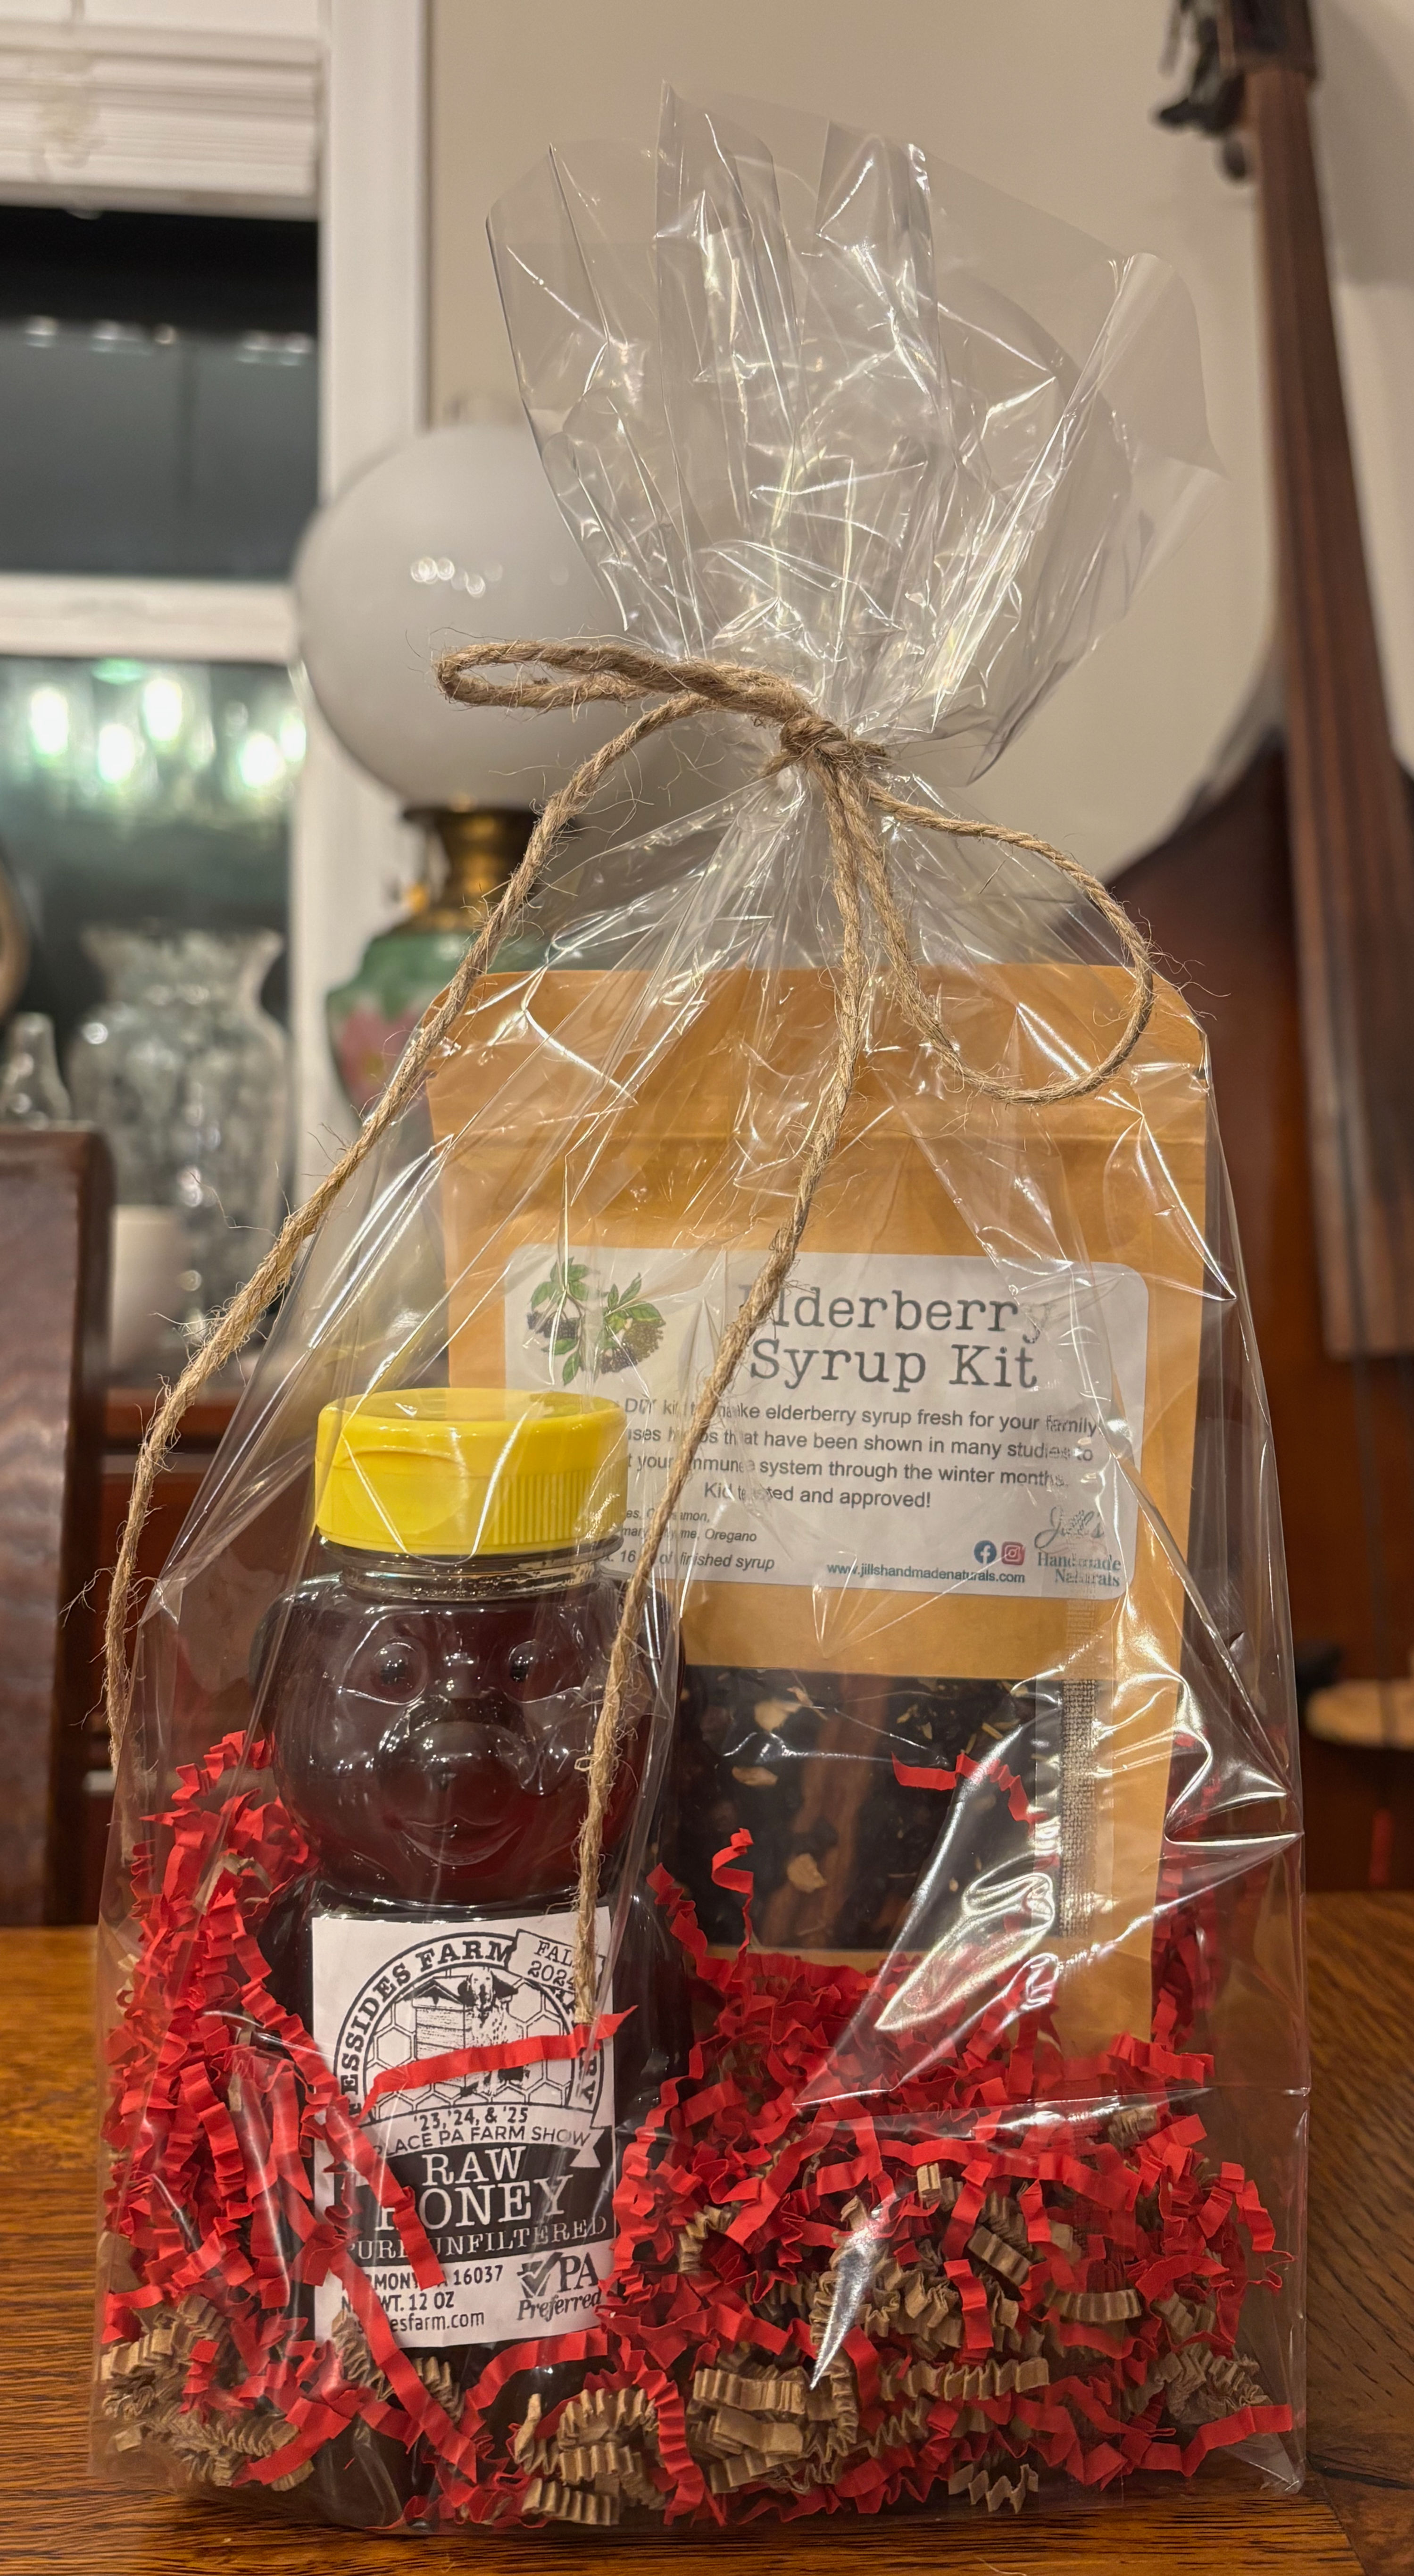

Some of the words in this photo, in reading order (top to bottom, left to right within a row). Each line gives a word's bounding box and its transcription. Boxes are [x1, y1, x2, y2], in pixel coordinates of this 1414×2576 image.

[750, 1338, 926, 1393] Syrup
[949, 1344, 1038, 1388] Kit
[765, 1404, 856, 1426] elderberry
[862, 1410, 911, 1428] syrup
[917, 1409, 962, 1426] fresh
[969, 1410, 994, 1427] for
[999, 1415, 1040, 1433] your
[724, 1430, 759, 1445] that
[764, 1431, 807, 1448] have
[814, 1432, 857, 1450] been
[864, 1434, 923, 1452] shown
[928, 1436, 944, 1453] in
[951, 1441, 1002, 1460] many
[637, 1456, 673, 1472] your
[692, 1457, 755, 1473] mmune
[760, 1459, 822, 1477] system
[829, 1460, 897, 1482] through
[904, 1463, 932, 1479] the
[938, 1466, 995, 1484] winter
[704, 1482, 732, 1499] Kid
[800, 1487, 833, 1503] and
[840, 1492, 931, 1509] approved!
[705, 1528, 757, 1542] Oregano
[621, 1550, 636, 1563] 16
[736, 1560, 775, 1572] syrup
[827, 1563, 1025, 1584] www.jillshandmadenaturals.com
[416, 1940, 513, 1972] FARM
[533, 1940, 574, 1968] FAL
[484, 2110, 498, 2124] &
[503, 2107, 528, 2124] '25
[440, 2129, 465, 2146] PA
[471, 2125, 526, 2141] FARM
[531, 2127, 591, 2147] SHOW
[422, 2146, 526, 2186] RAW
[453, 2265, 503, 2285] 16037
[558, 2251, 599, 2293] PA
[378, 2294, 404, 2312] WT.
[408, 2293, 427, 2310] 12
[433, 2291, 455, 2309] OZ
[516, 2287, 601, 2322] Preferred
